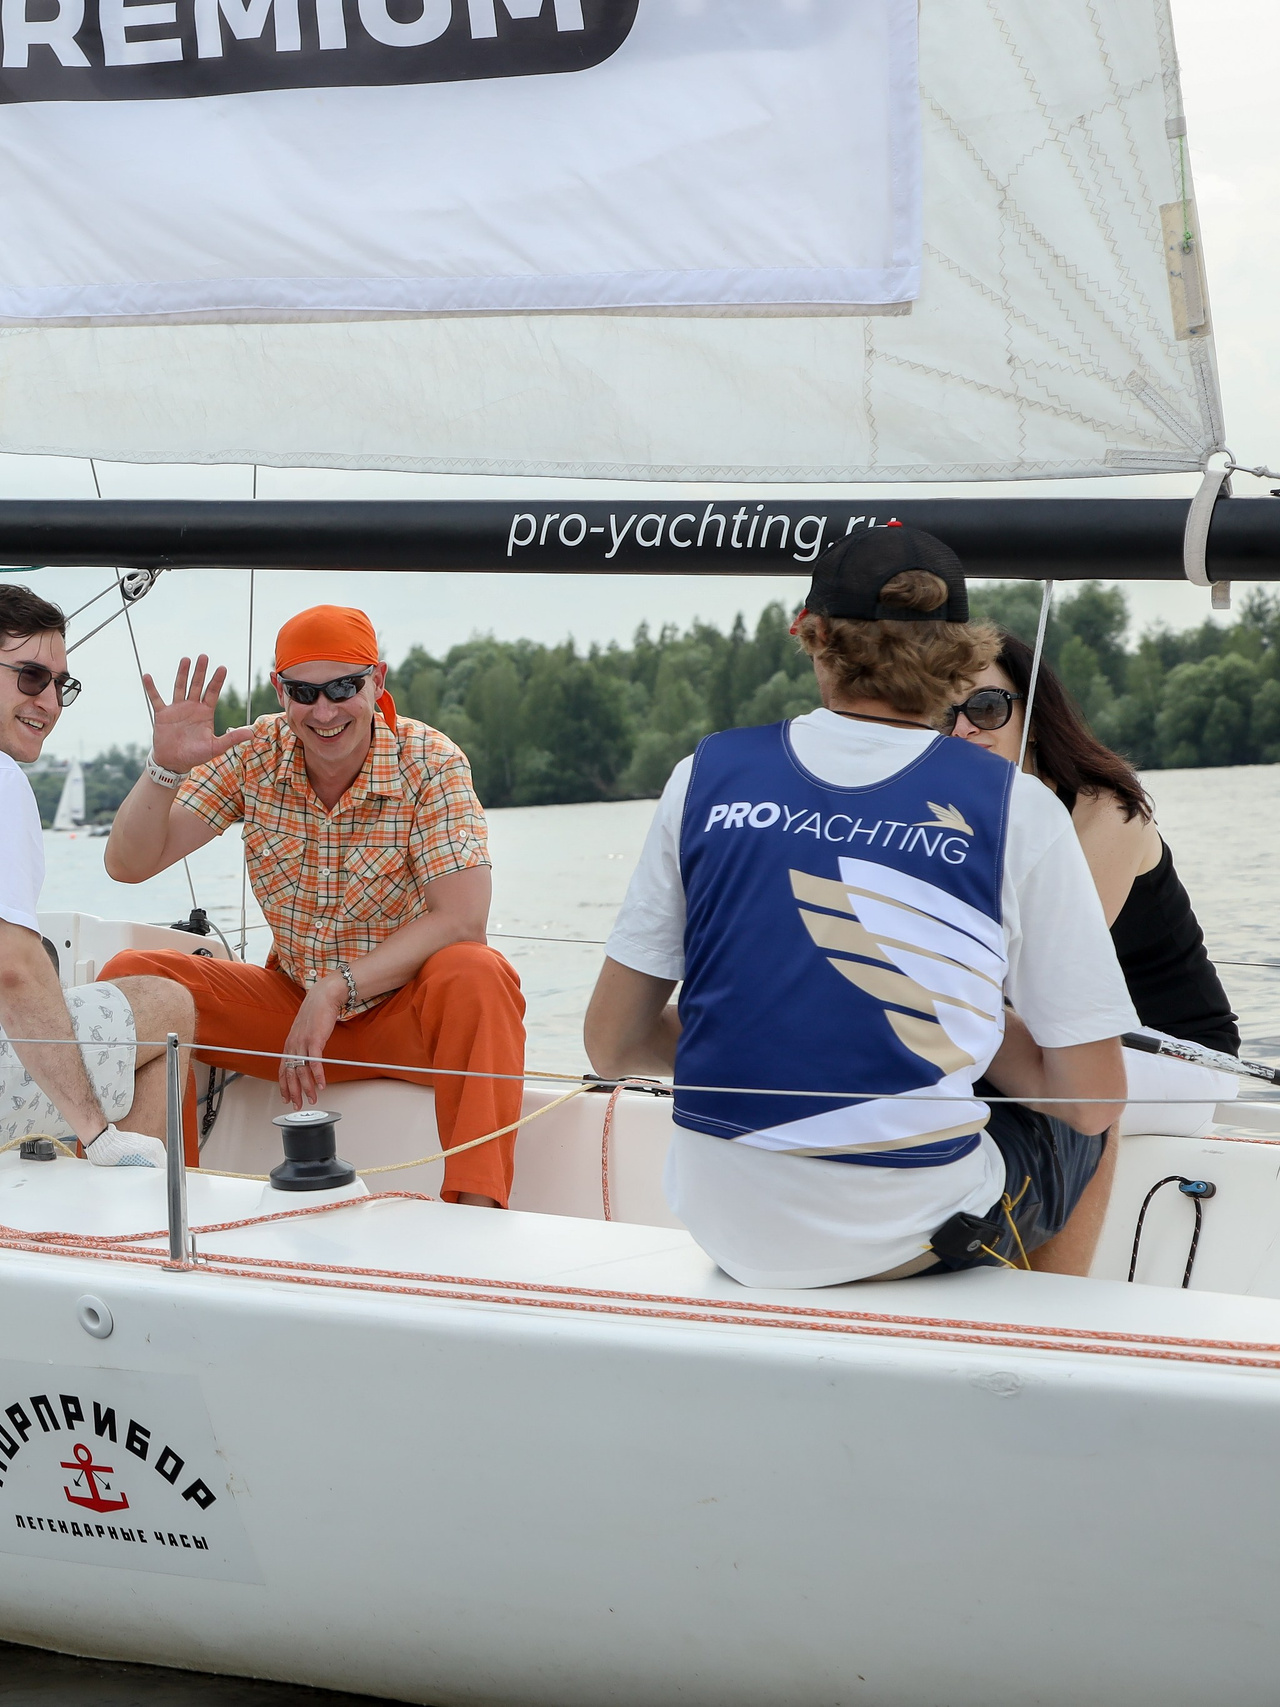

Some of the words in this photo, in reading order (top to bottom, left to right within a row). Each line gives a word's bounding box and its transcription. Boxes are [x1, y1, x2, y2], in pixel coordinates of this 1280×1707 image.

[506, 503, 898, 561] pro-yachting.r
[704, 801, 970, 865] PROYACHTING
[15, 1514, 148, 1544] ЛЕГЕНДАРНЫЕ
[153, 1531, 209, 1551] ЧАСЫ
